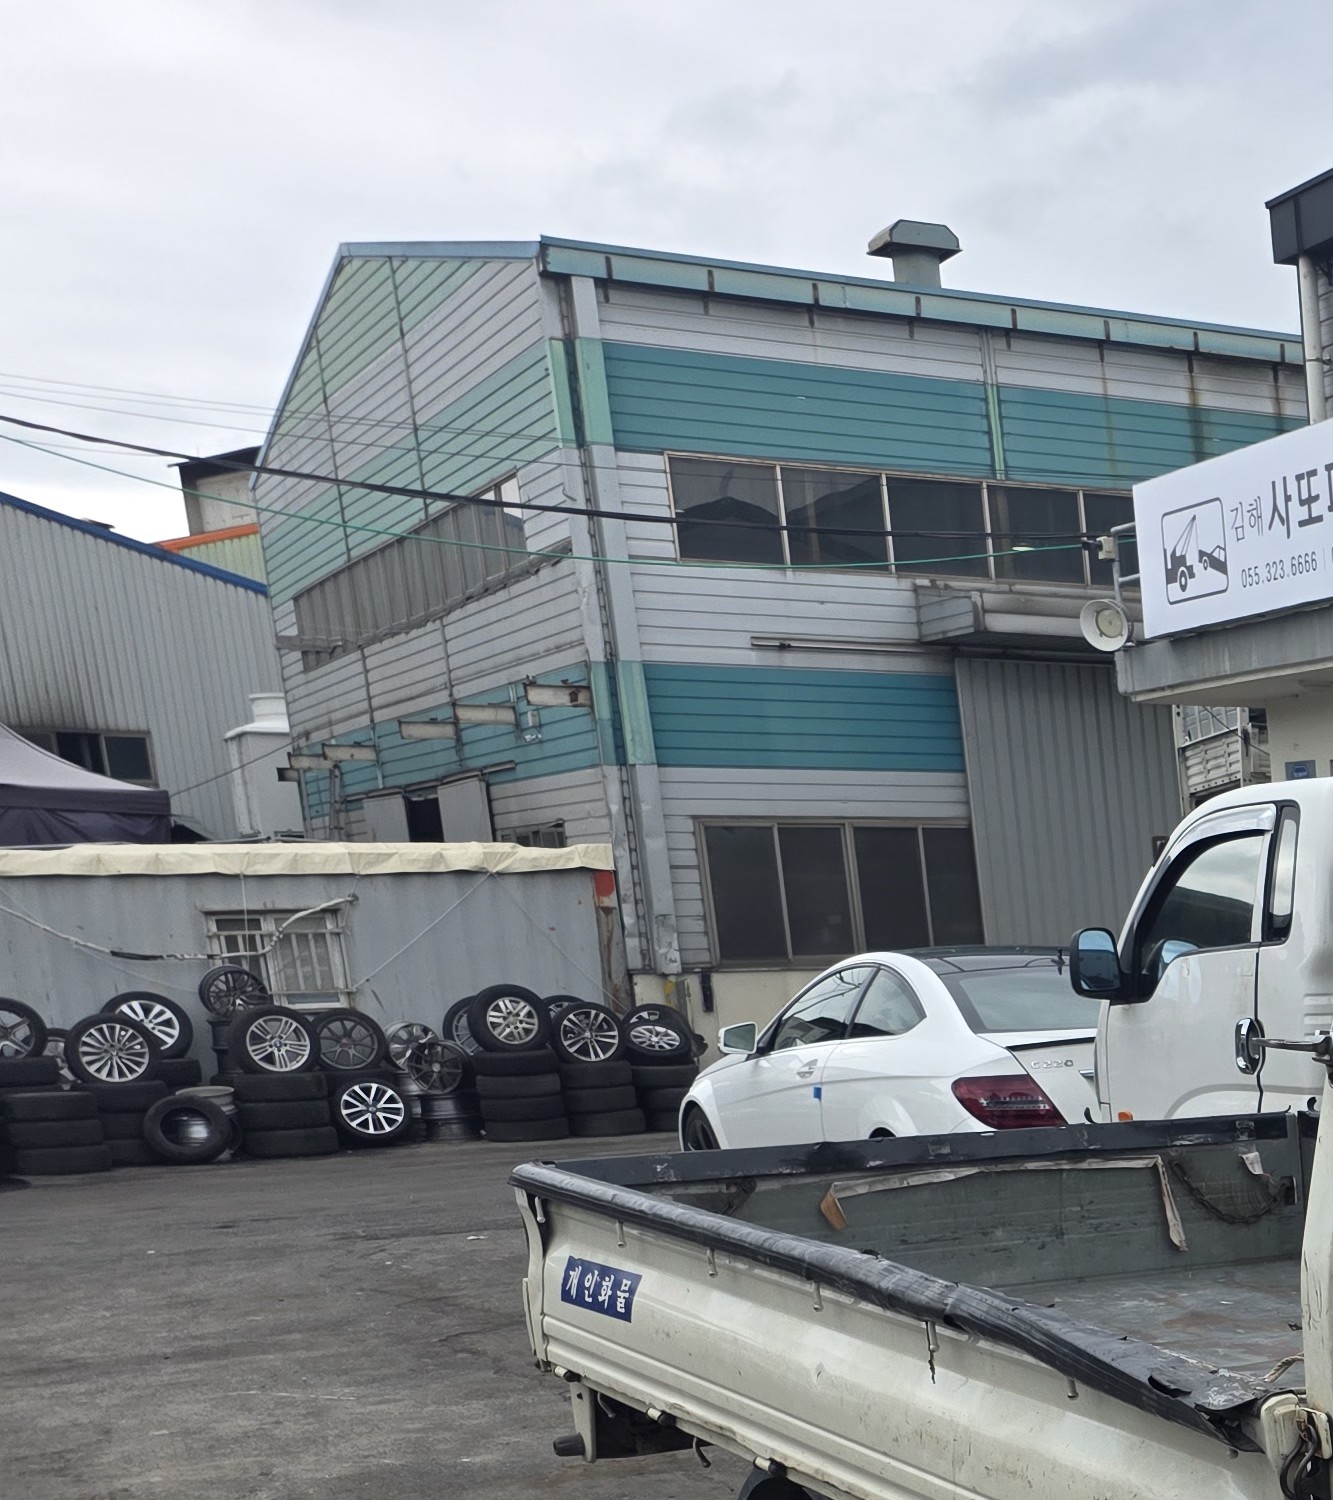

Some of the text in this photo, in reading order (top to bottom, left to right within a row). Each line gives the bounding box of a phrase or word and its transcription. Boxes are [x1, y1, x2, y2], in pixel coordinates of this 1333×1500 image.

[1230, 495, 1264, 542] 김해
[1241, 550, 1318, 588] 055.323.6666
[565, 1265, 632, 1314] 개인화물
